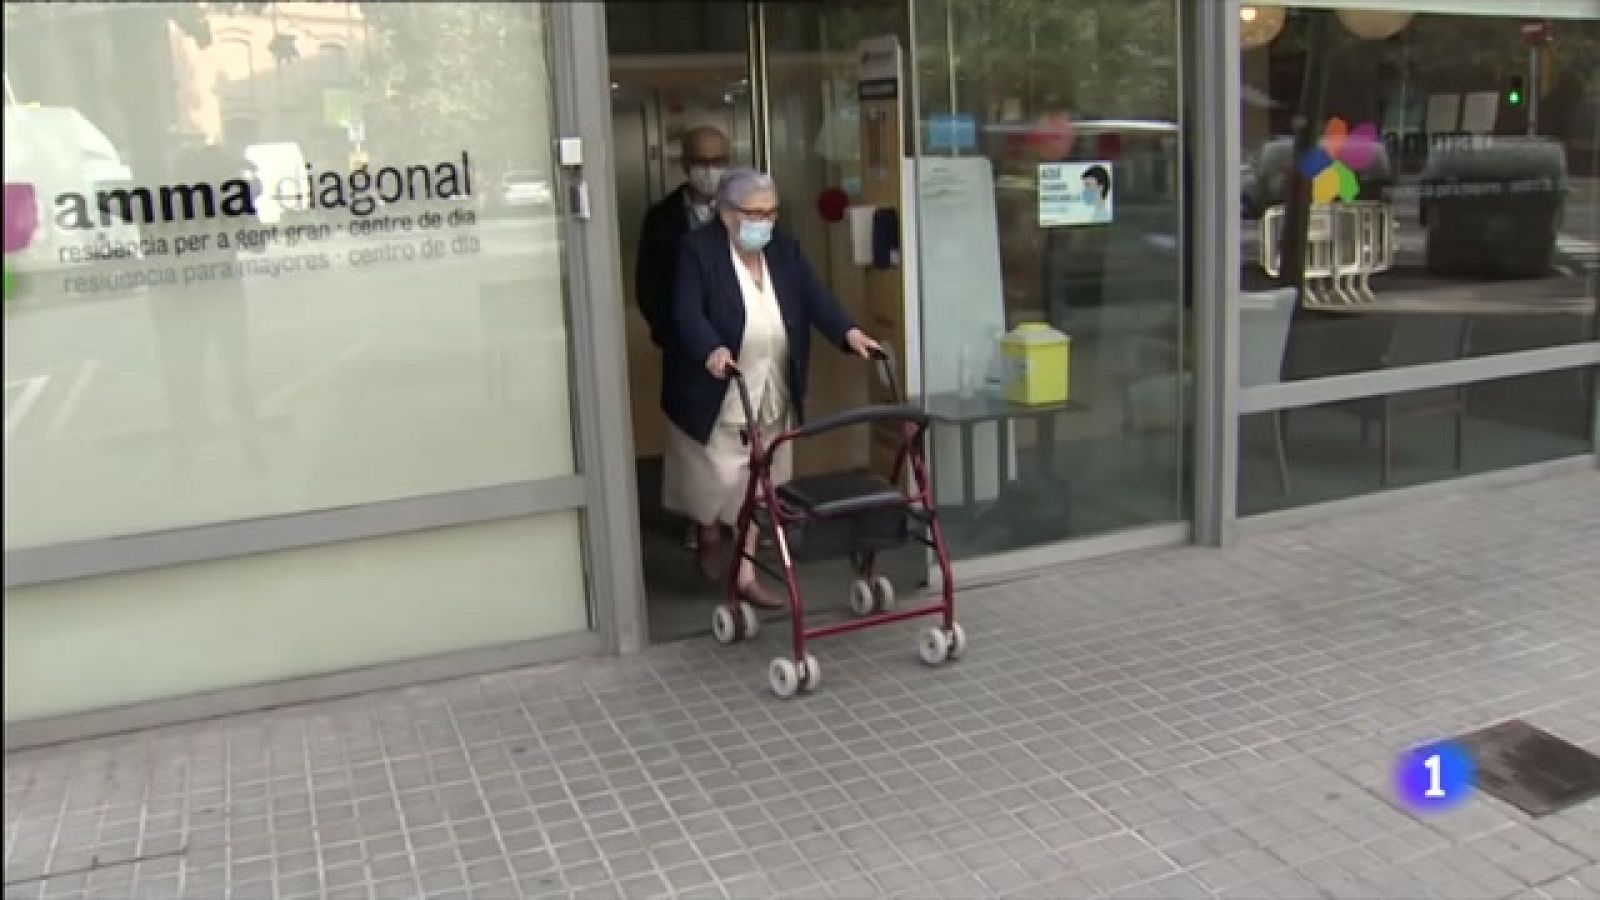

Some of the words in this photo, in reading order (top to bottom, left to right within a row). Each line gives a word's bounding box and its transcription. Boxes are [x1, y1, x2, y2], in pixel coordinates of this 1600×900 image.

[54, 178, 257, 230] amma
[272, 151, 472, 216] diagonal
[174, 233, 211, 257] per
[350, 214, 411, 236] centre
[417, 209, 442, 230] de
[447, 207, 476, 227] dia
[350, 244, 415, 267] centro
[420, 238, 446, 258] de
